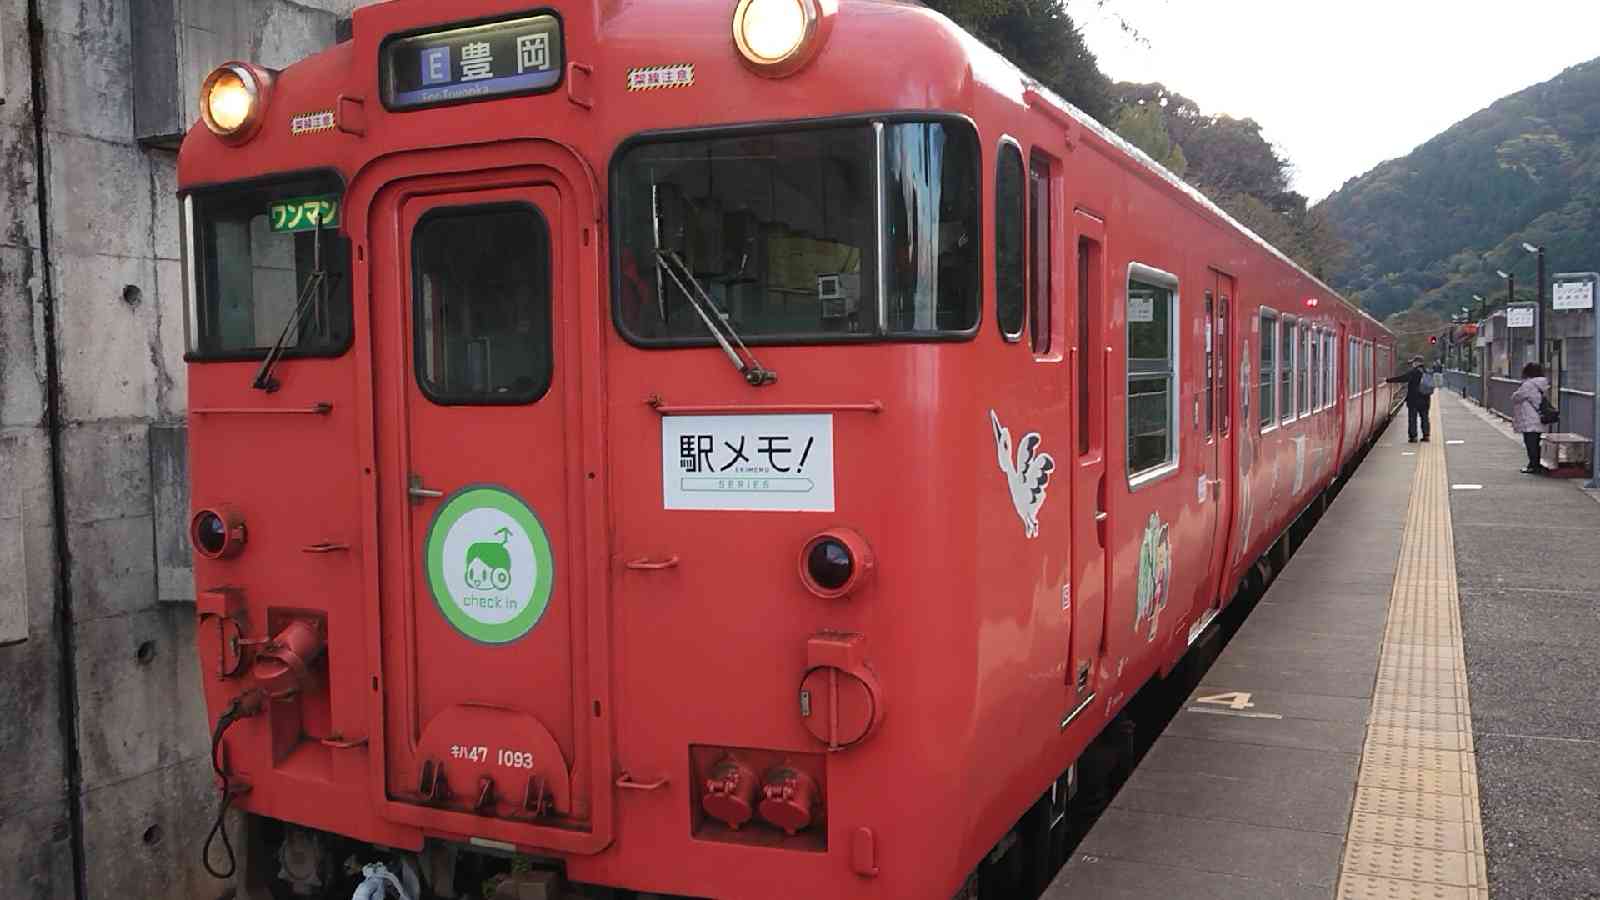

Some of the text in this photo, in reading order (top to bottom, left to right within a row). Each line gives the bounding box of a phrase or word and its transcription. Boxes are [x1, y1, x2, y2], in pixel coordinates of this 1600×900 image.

[429, 31, 551, 82] E 豊岡
[271, 200, 338, 229] ワンマン
[718, 480, 770, 489] SERIES
[463, 593, 518, 609] check in
[1197, 691, 1256, 710] 4
[450, 744, 534, 769] キハ47 1093
